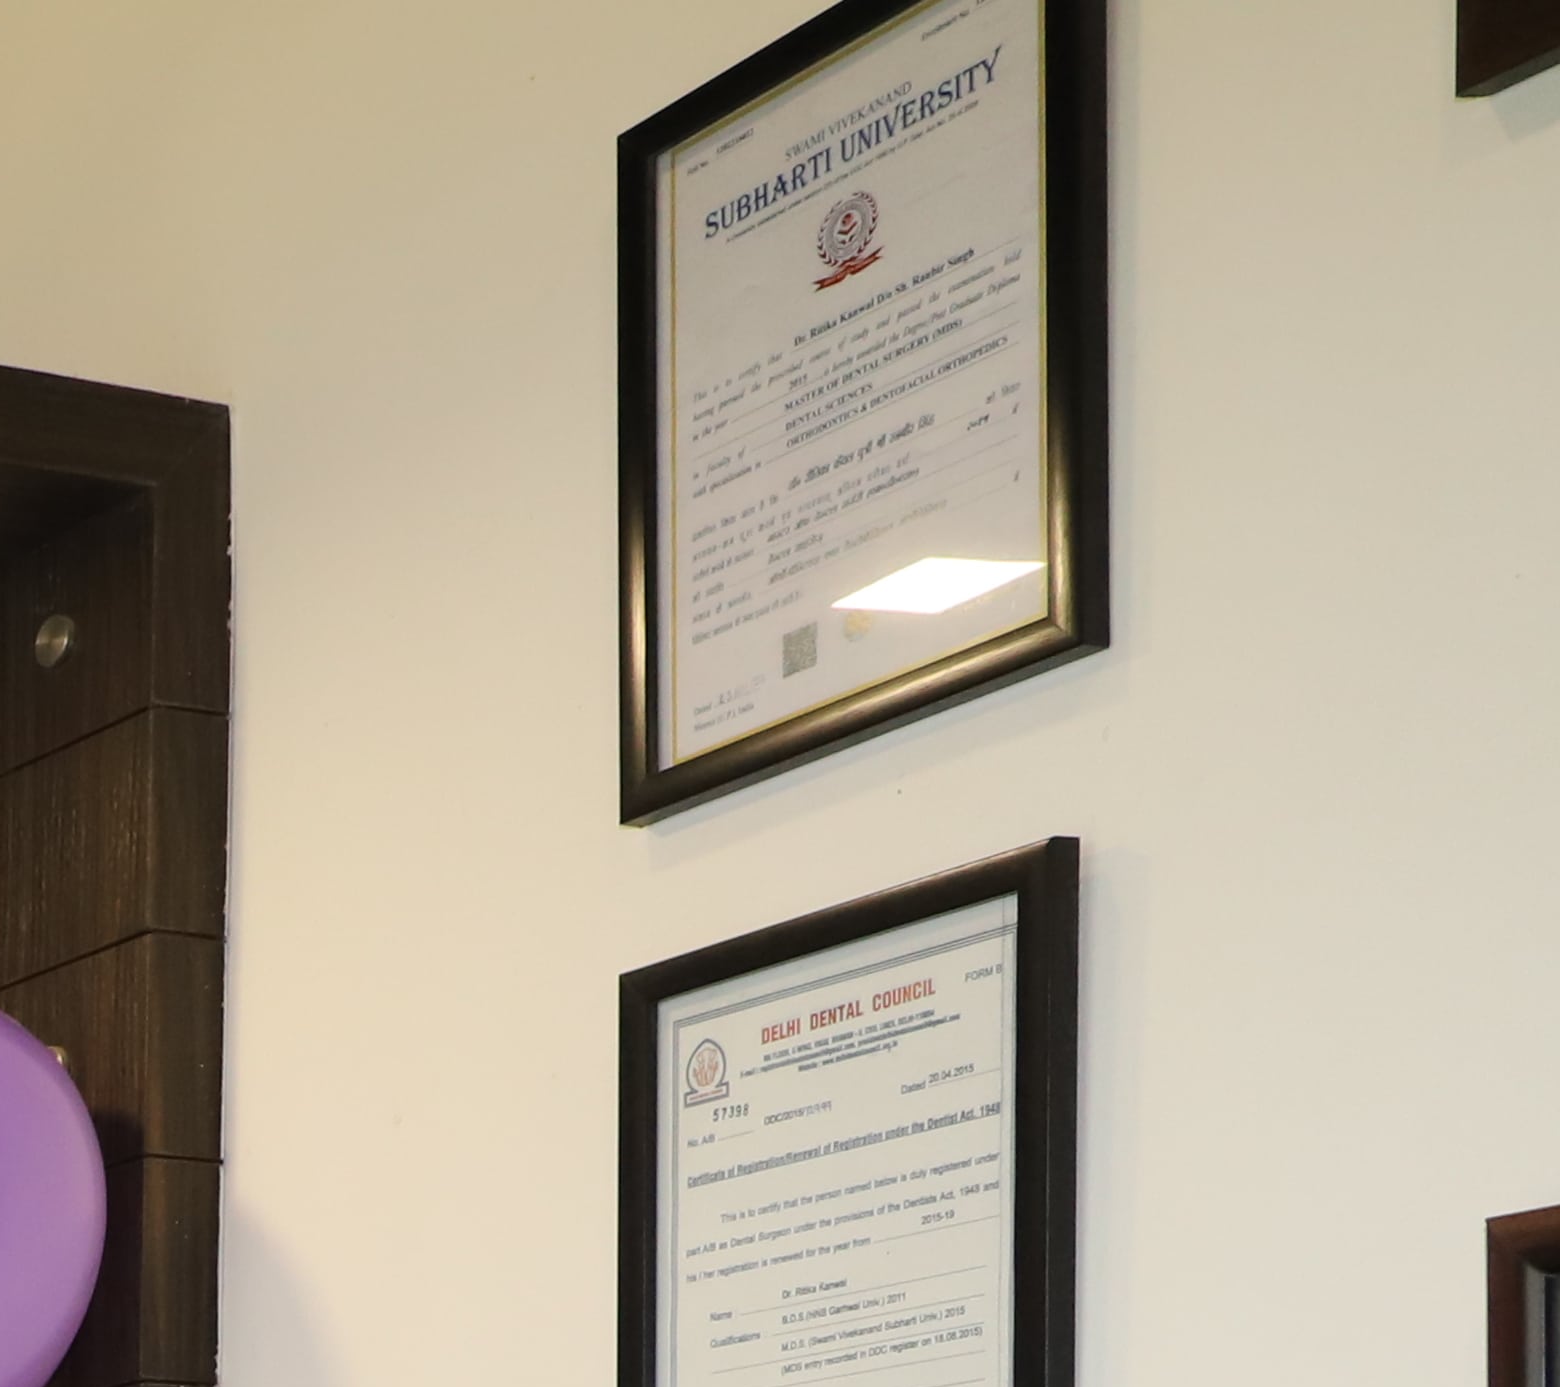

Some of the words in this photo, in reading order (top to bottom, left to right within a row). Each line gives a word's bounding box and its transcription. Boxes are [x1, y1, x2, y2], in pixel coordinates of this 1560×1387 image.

[786, 131, 826, 161] SWAMI
[828, 82, 912, 135] VIVEKANAND
[705, 150, 831, 239] SUBHARTI
[839, 45, 1002, 163] UNIVERSITY
[785, 406, 822, 431] DENTAL
[823, 383, 874, 414] SCIENCES
[965, 966, 993, 982] FORM
[761, 1017, 802, 1045] DELHI
[810, 1000, 864, 1031] DENTAL
[872, 978, 936, 1012] COUNCIL
[901, 1080, 926, 1095] Dated
[928, 1064, 975, 1084] 20.04.2015
[712, 1103, 750, 1123] 57398
[921, 1208, 955, 1226] 2015-19
[709, 1310, 732, 1323] Name
[944, 1305, 966, 1319] 2015
[709, 1330, 761, 1349] Qualifications
